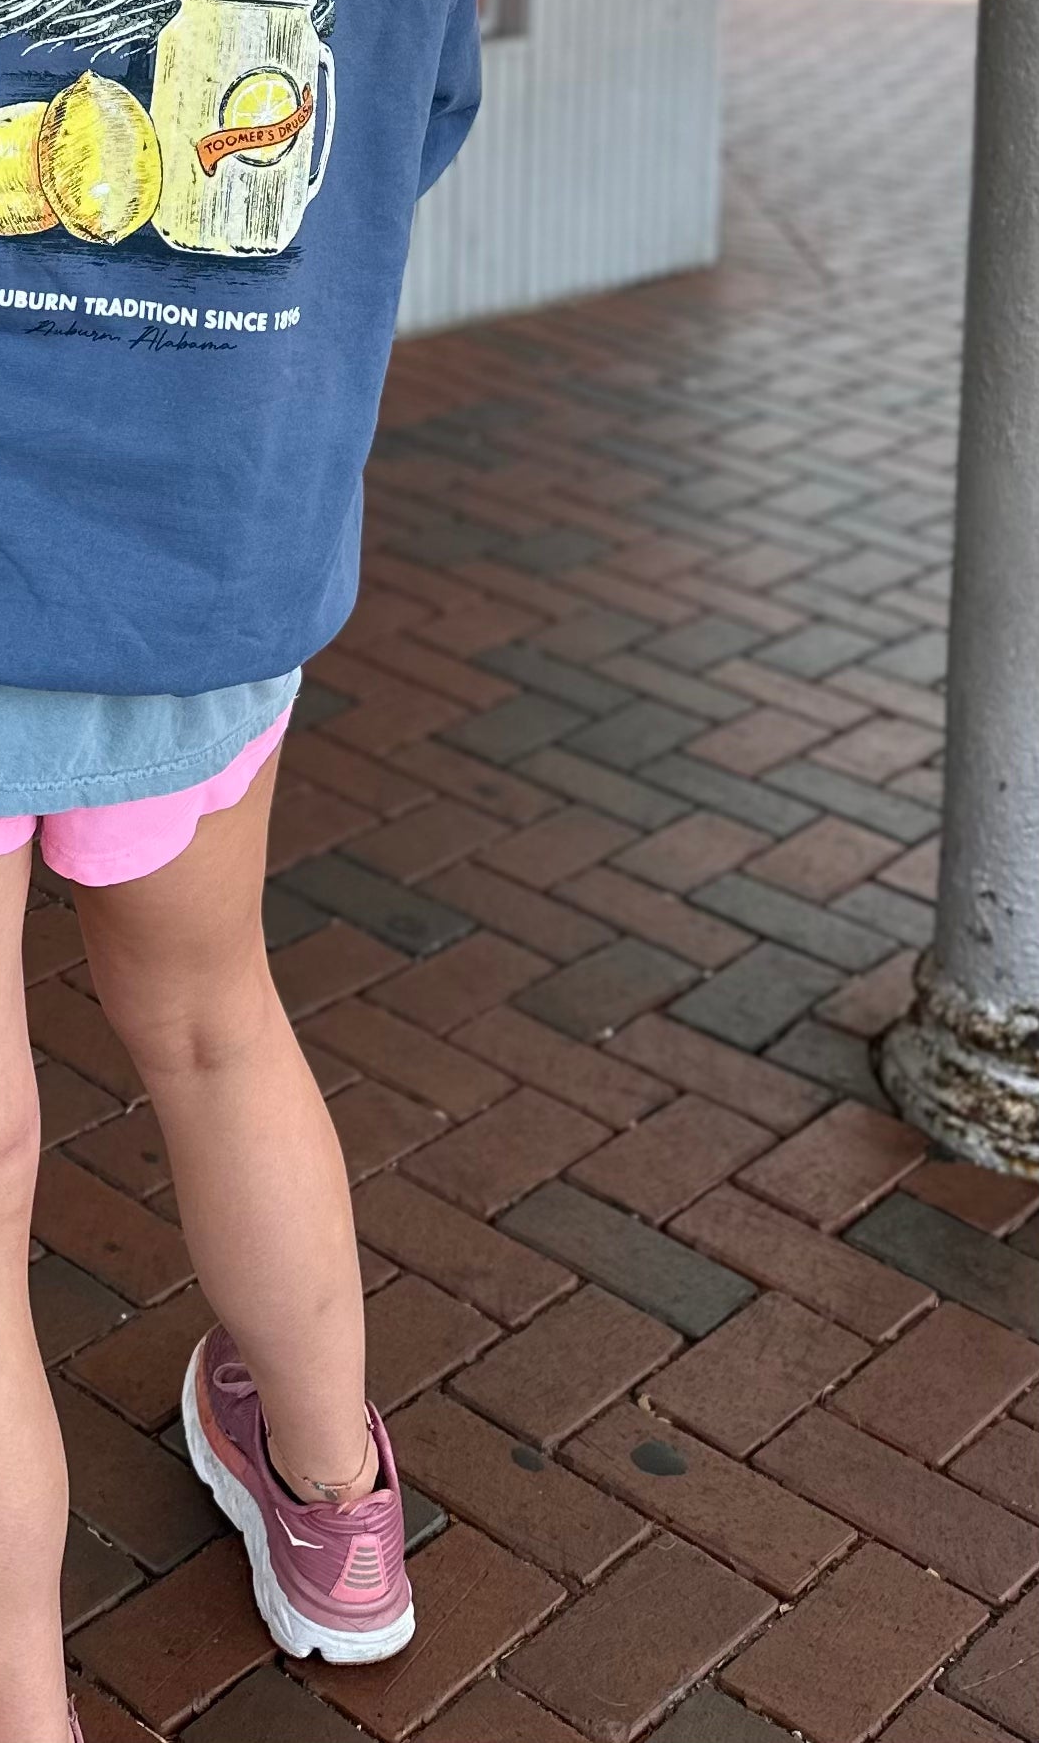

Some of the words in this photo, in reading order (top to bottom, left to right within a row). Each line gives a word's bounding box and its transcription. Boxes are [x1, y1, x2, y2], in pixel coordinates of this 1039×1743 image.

[203, 129, 276, 155] TOOMER'S
[278, 105, 309, 138] DRUGS
[83, 296, 198, 327] TRADITION
[203, 309, 268, 332] SINCE
[129, 325, 239, 351] Alabama
